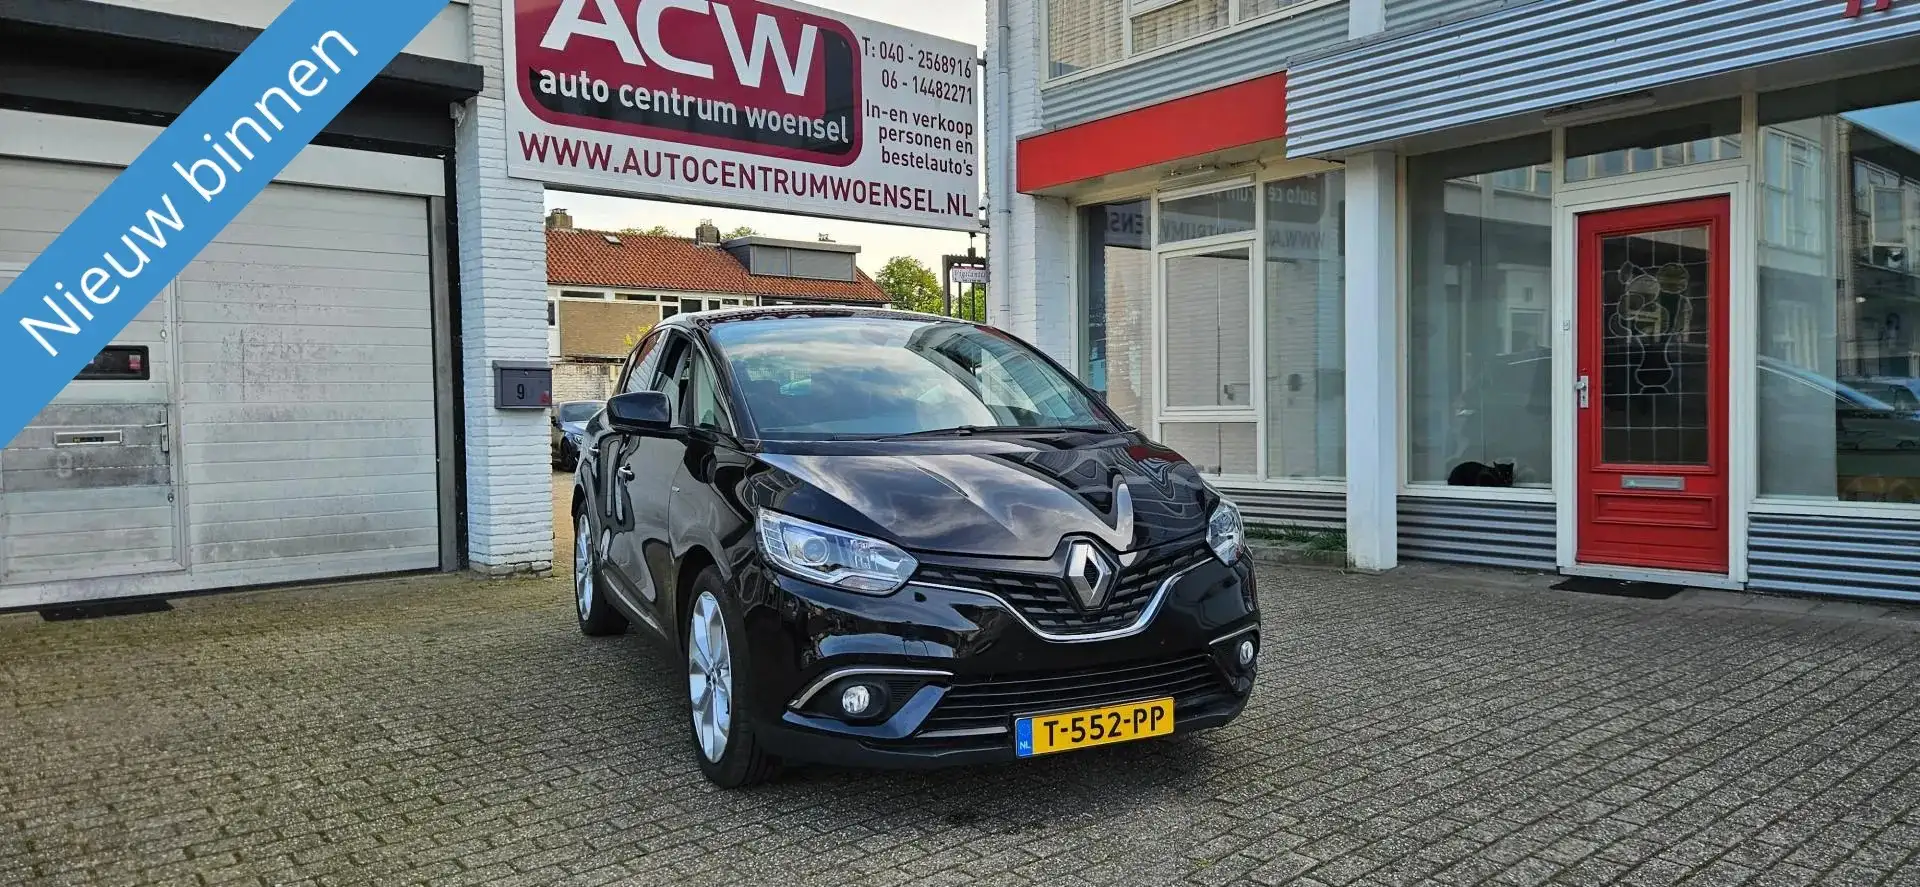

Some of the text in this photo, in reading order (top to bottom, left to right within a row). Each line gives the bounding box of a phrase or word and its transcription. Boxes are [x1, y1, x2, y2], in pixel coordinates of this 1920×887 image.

[539, 0, 819, 97] ACW
[861, 37, 876, 57] T:
[879, 41, 904, 64] 040
[917, 50, 972, 79] 2568916
[539, 68, 849, 144] auto centrum woensel
[881, 69, 898, 90] 06
[912, 75, 973, 105] 14482271
[865, 99, 974, 137] In-en verkoop
[878, 124, 974, 156] personen en
[518, 131, 974, 219] WWW.AUTOCENTRUMWOENSEL.NL
[881, 146, 974, 177] bestelauto's
[516, 383, 525, 400] 9
[1019, 705, 1165, 750] NL T-552-PP
